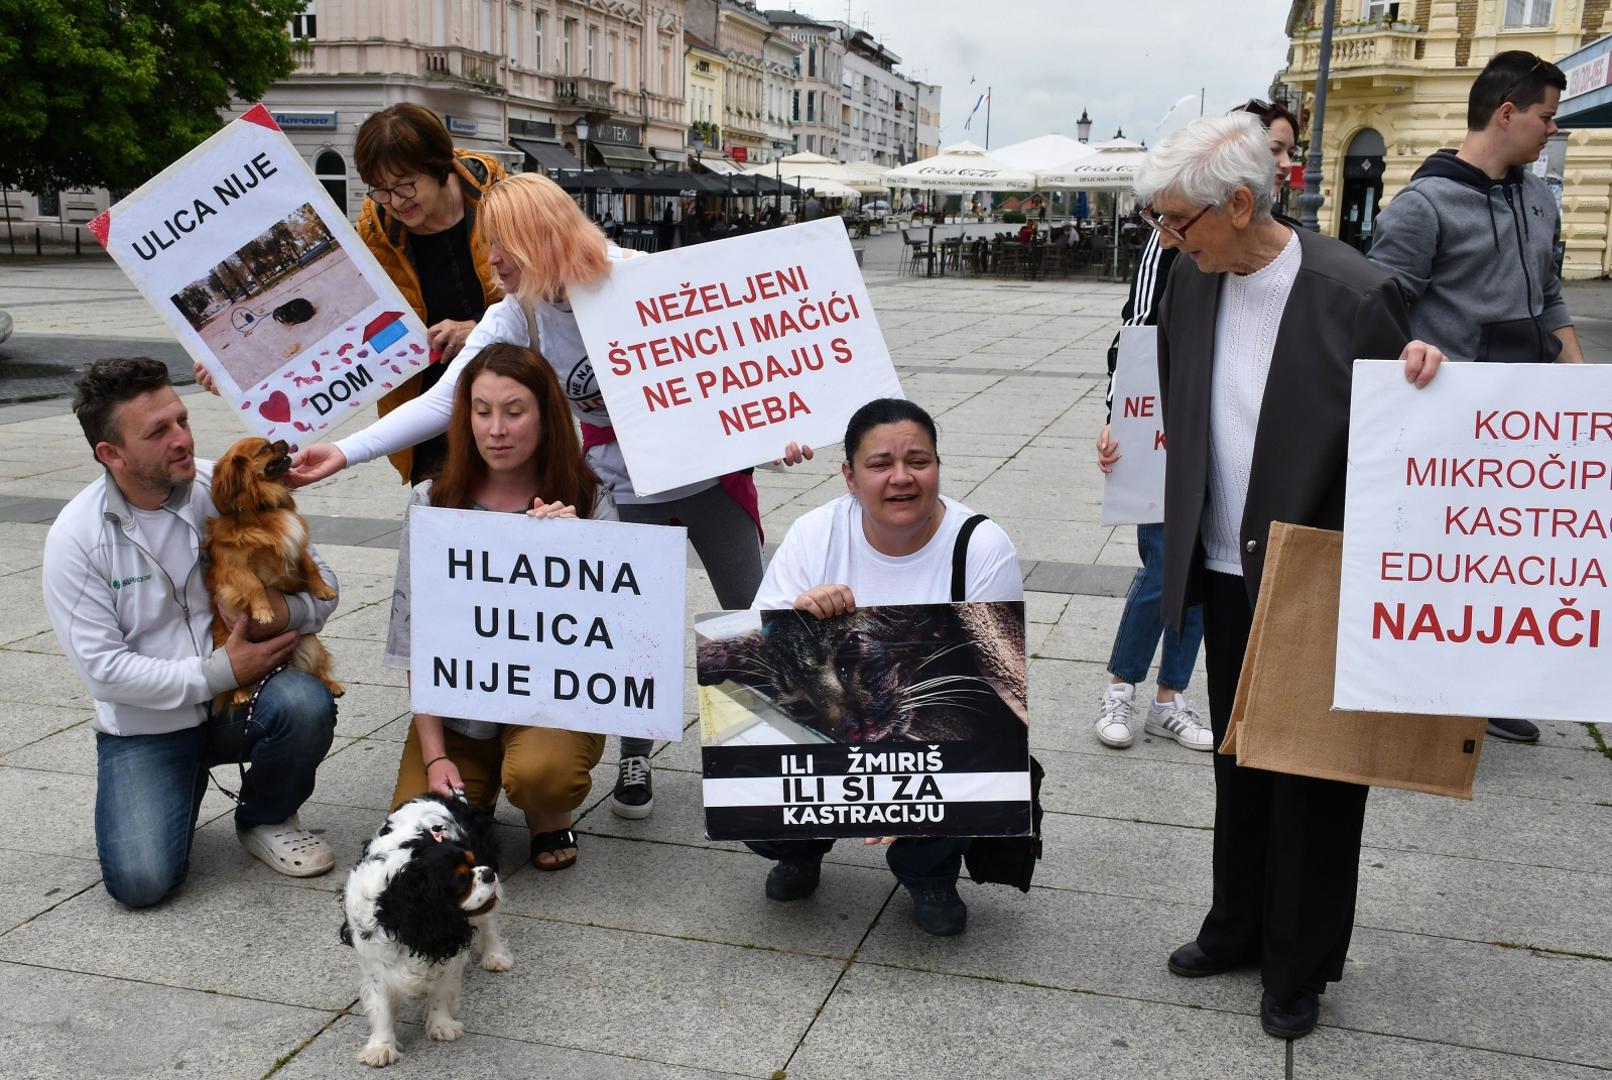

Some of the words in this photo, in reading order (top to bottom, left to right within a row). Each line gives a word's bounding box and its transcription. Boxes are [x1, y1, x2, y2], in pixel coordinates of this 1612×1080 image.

[131, 198, 218, 261] ULICA
[212, 152, 278, 206] NIJE
[635, 265, 809, 327] NEŽELJENI
[608, 325, 728, 376] ŠTENCI
[732, 321, 746, 348] I
[750, 290, 860, 343] MAČIĆI
[309, 364, 374, 416] DOM
[642, 377, 692, 412] NE
[696, 344, 825, 399] PADAJU
[830, 337, 853, 364] S
[718, 391, 811, 436] NEBA
[1123, 396, 1156, 418] NE
[1474, 410, 1612, 441] KONTR
[1406, 453, 1612, 491] MIKROČIP
[1445, 506, 1612, 539] KASTRA
[448, 547, 641, 596] HLADNA
[1380, 552, 1608, 588] EDUKACIJA
[474, 605, 614, 650] ULICA
[1372, 597, 1601, 648] NAJJAČI
[433, 656, 531, 697] NIJE
[554, 668, 655, 710] DOM
[781, 754, 814, 775] ILI
[847, 745, 944, 774] ŽMIRIŠ
[782, 777, 825, 803] ILI
[842, 776, 875, 803] SI
[891, 775, 944, 801] ZA
[783, 804, 945, 826] KASTRACIJU
